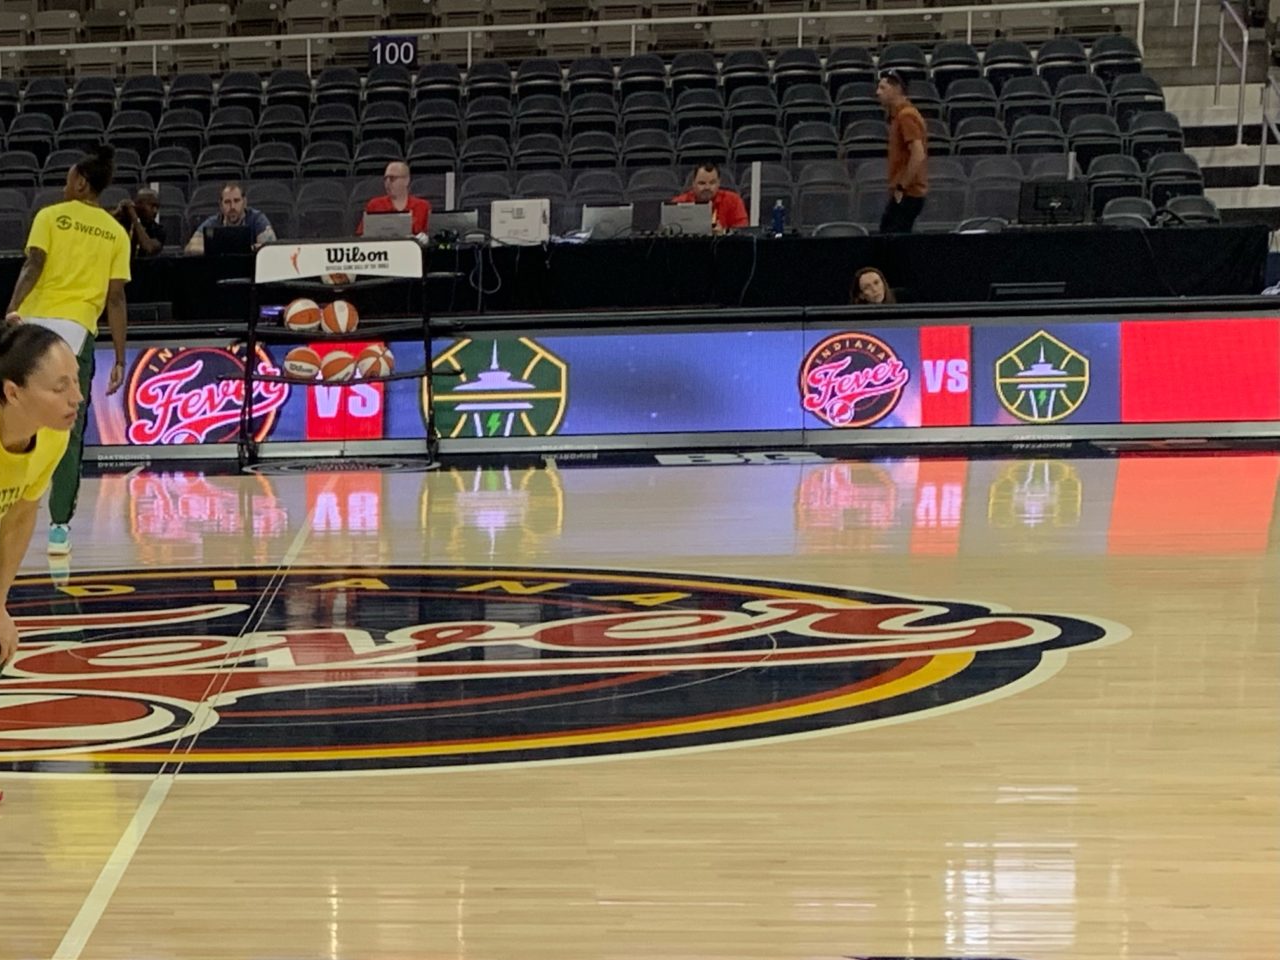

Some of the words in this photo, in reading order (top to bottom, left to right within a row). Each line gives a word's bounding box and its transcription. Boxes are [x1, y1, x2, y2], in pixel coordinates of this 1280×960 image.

[372, 42, 414, 65] 100
[74, 221, 117, 242] SWEDISH
[325, 246, 389, 263] Wilson
[816, 340, 886, 364] INDIANA
[805, 356, 909, 411] Fever
[923, 358, 969, 393] VS
[314, 368, 380, 418] VS
